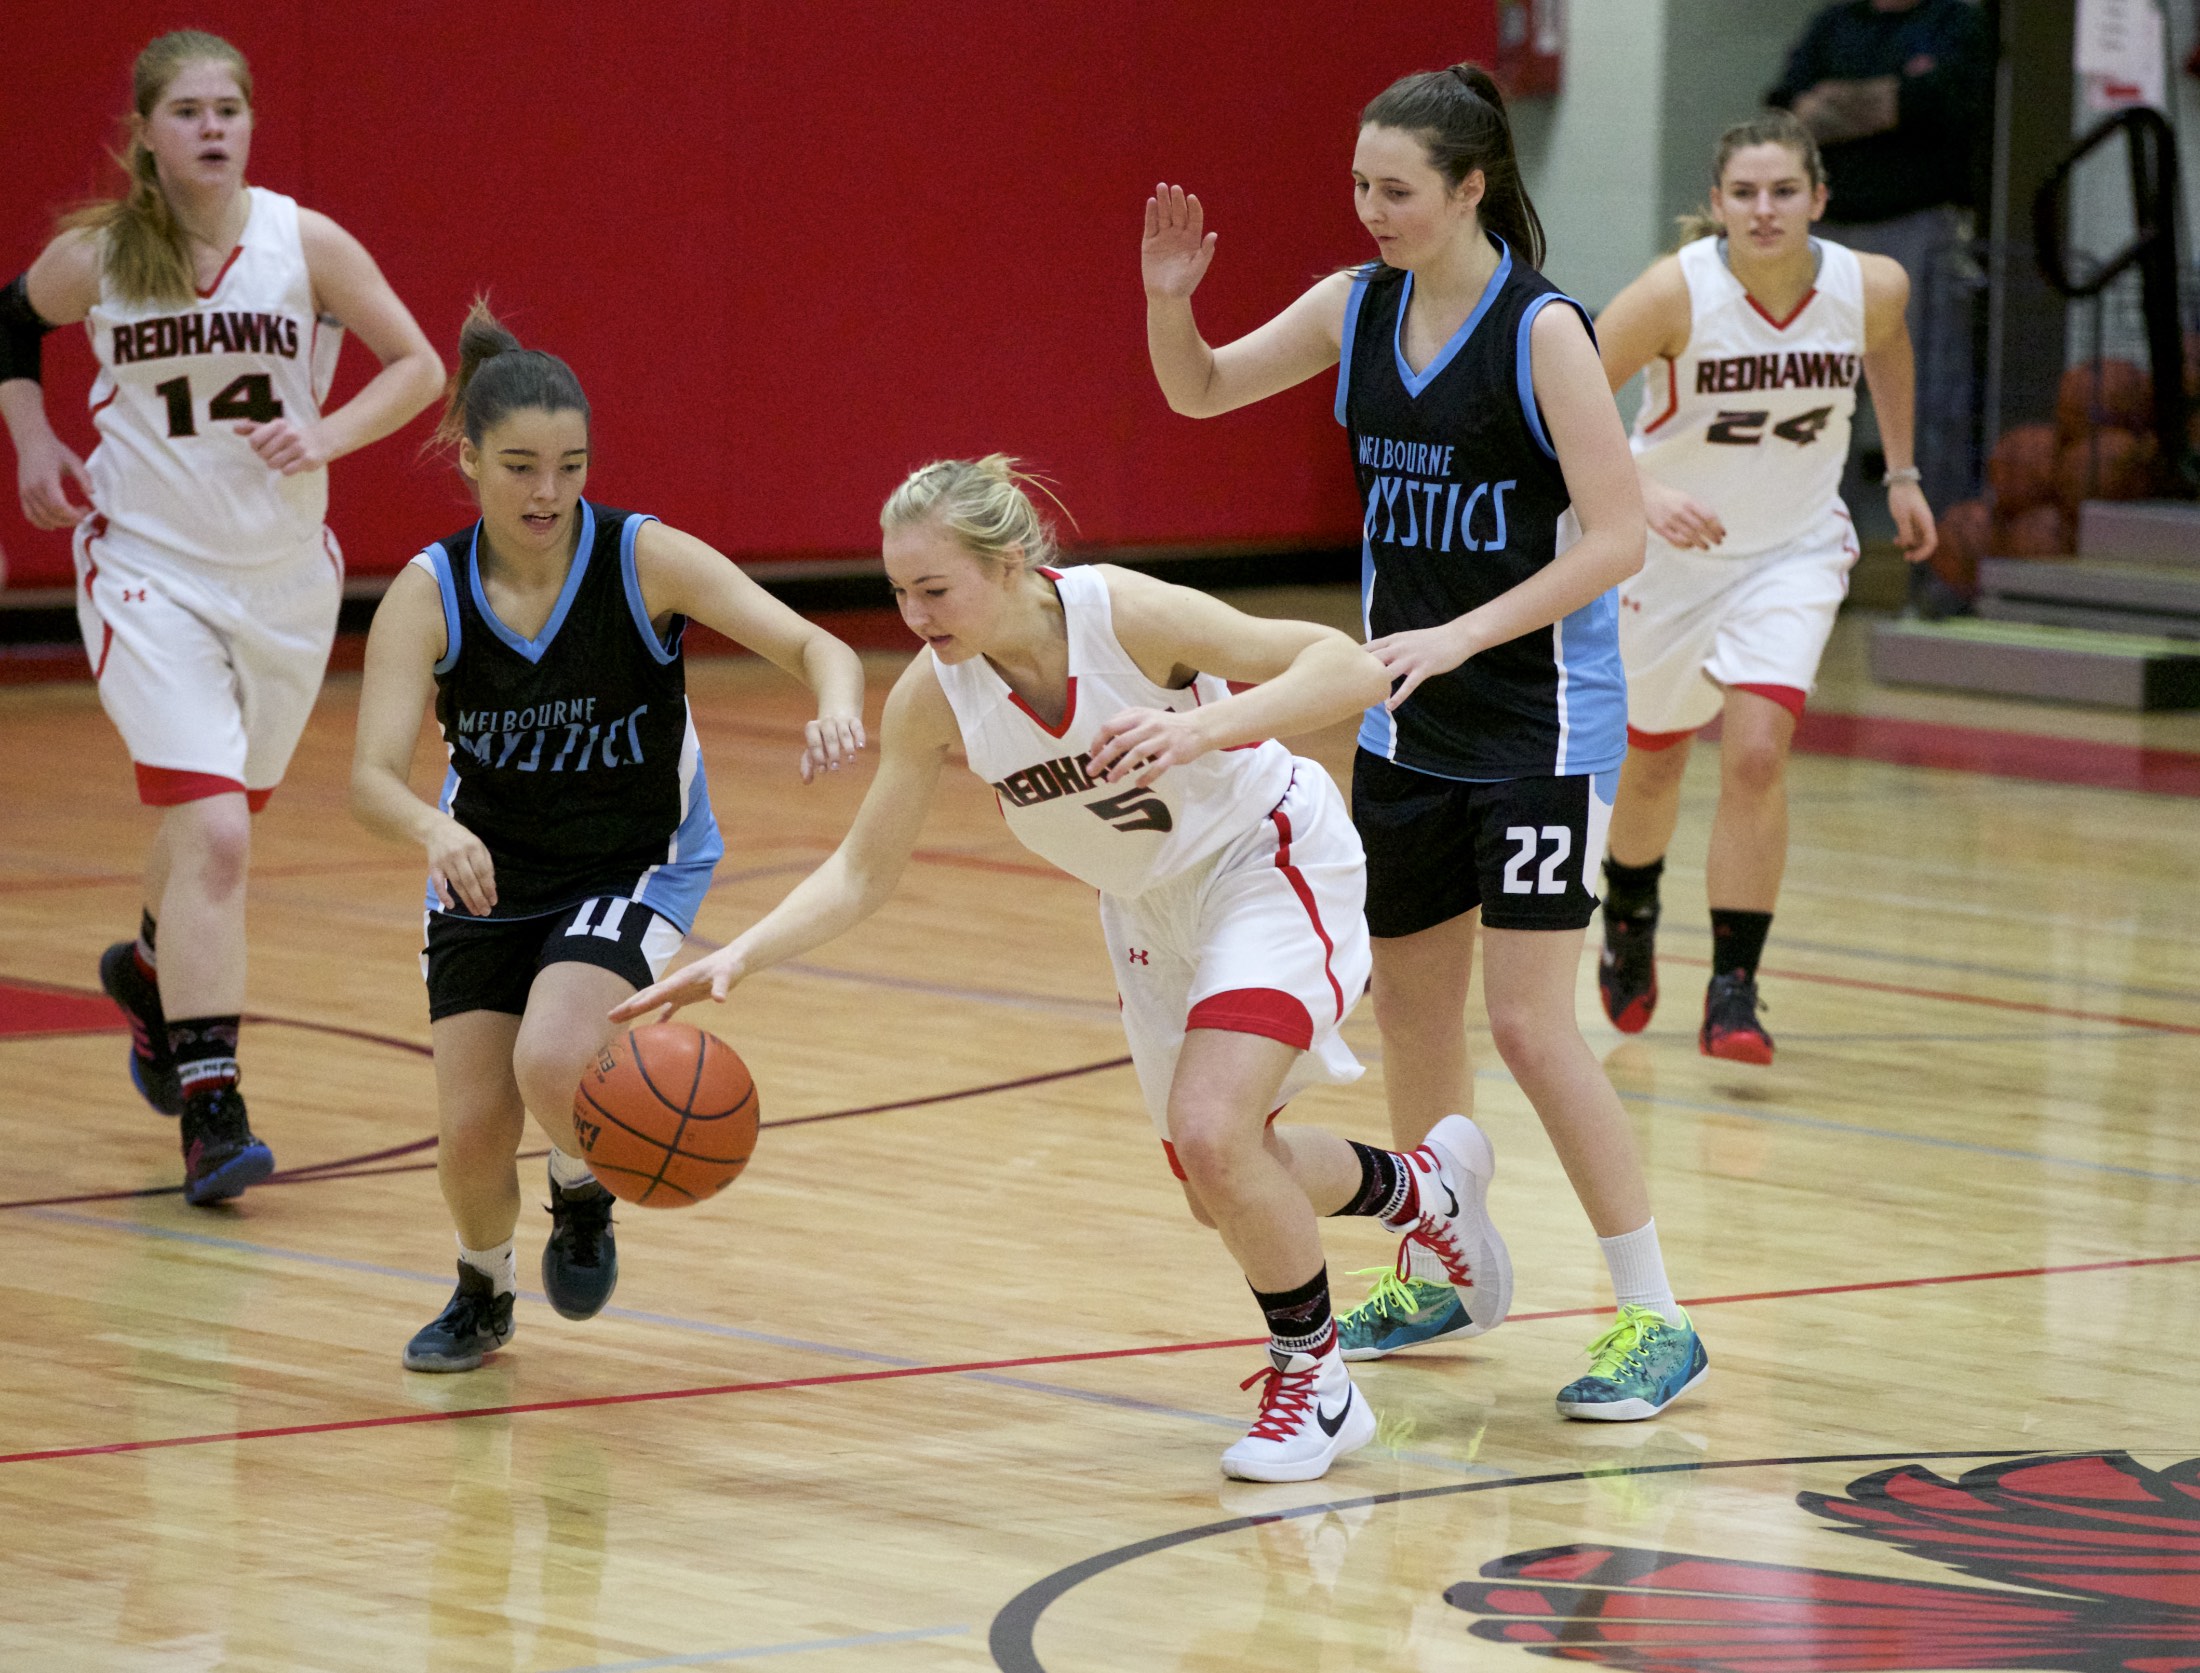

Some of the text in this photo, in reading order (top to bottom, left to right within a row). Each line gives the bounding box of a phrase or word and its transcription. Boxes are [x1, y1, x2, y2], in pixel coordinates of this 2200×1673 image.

[113, 311, 298, 365] REDHAWKS
[1696, 352, 1858, 394] REDHAWKS
[156, 374, 284, 438] 14
[1707, 404, 1834, 447] 24
[1358, 434, 1455, 477] MELBOURNE
[458, 697, 597, 733] MELBOURNE
[1084, 785, 1173, 833] 5
[1503, 825, 1571, 895] 22
[564, 898, 622, 942] 11
